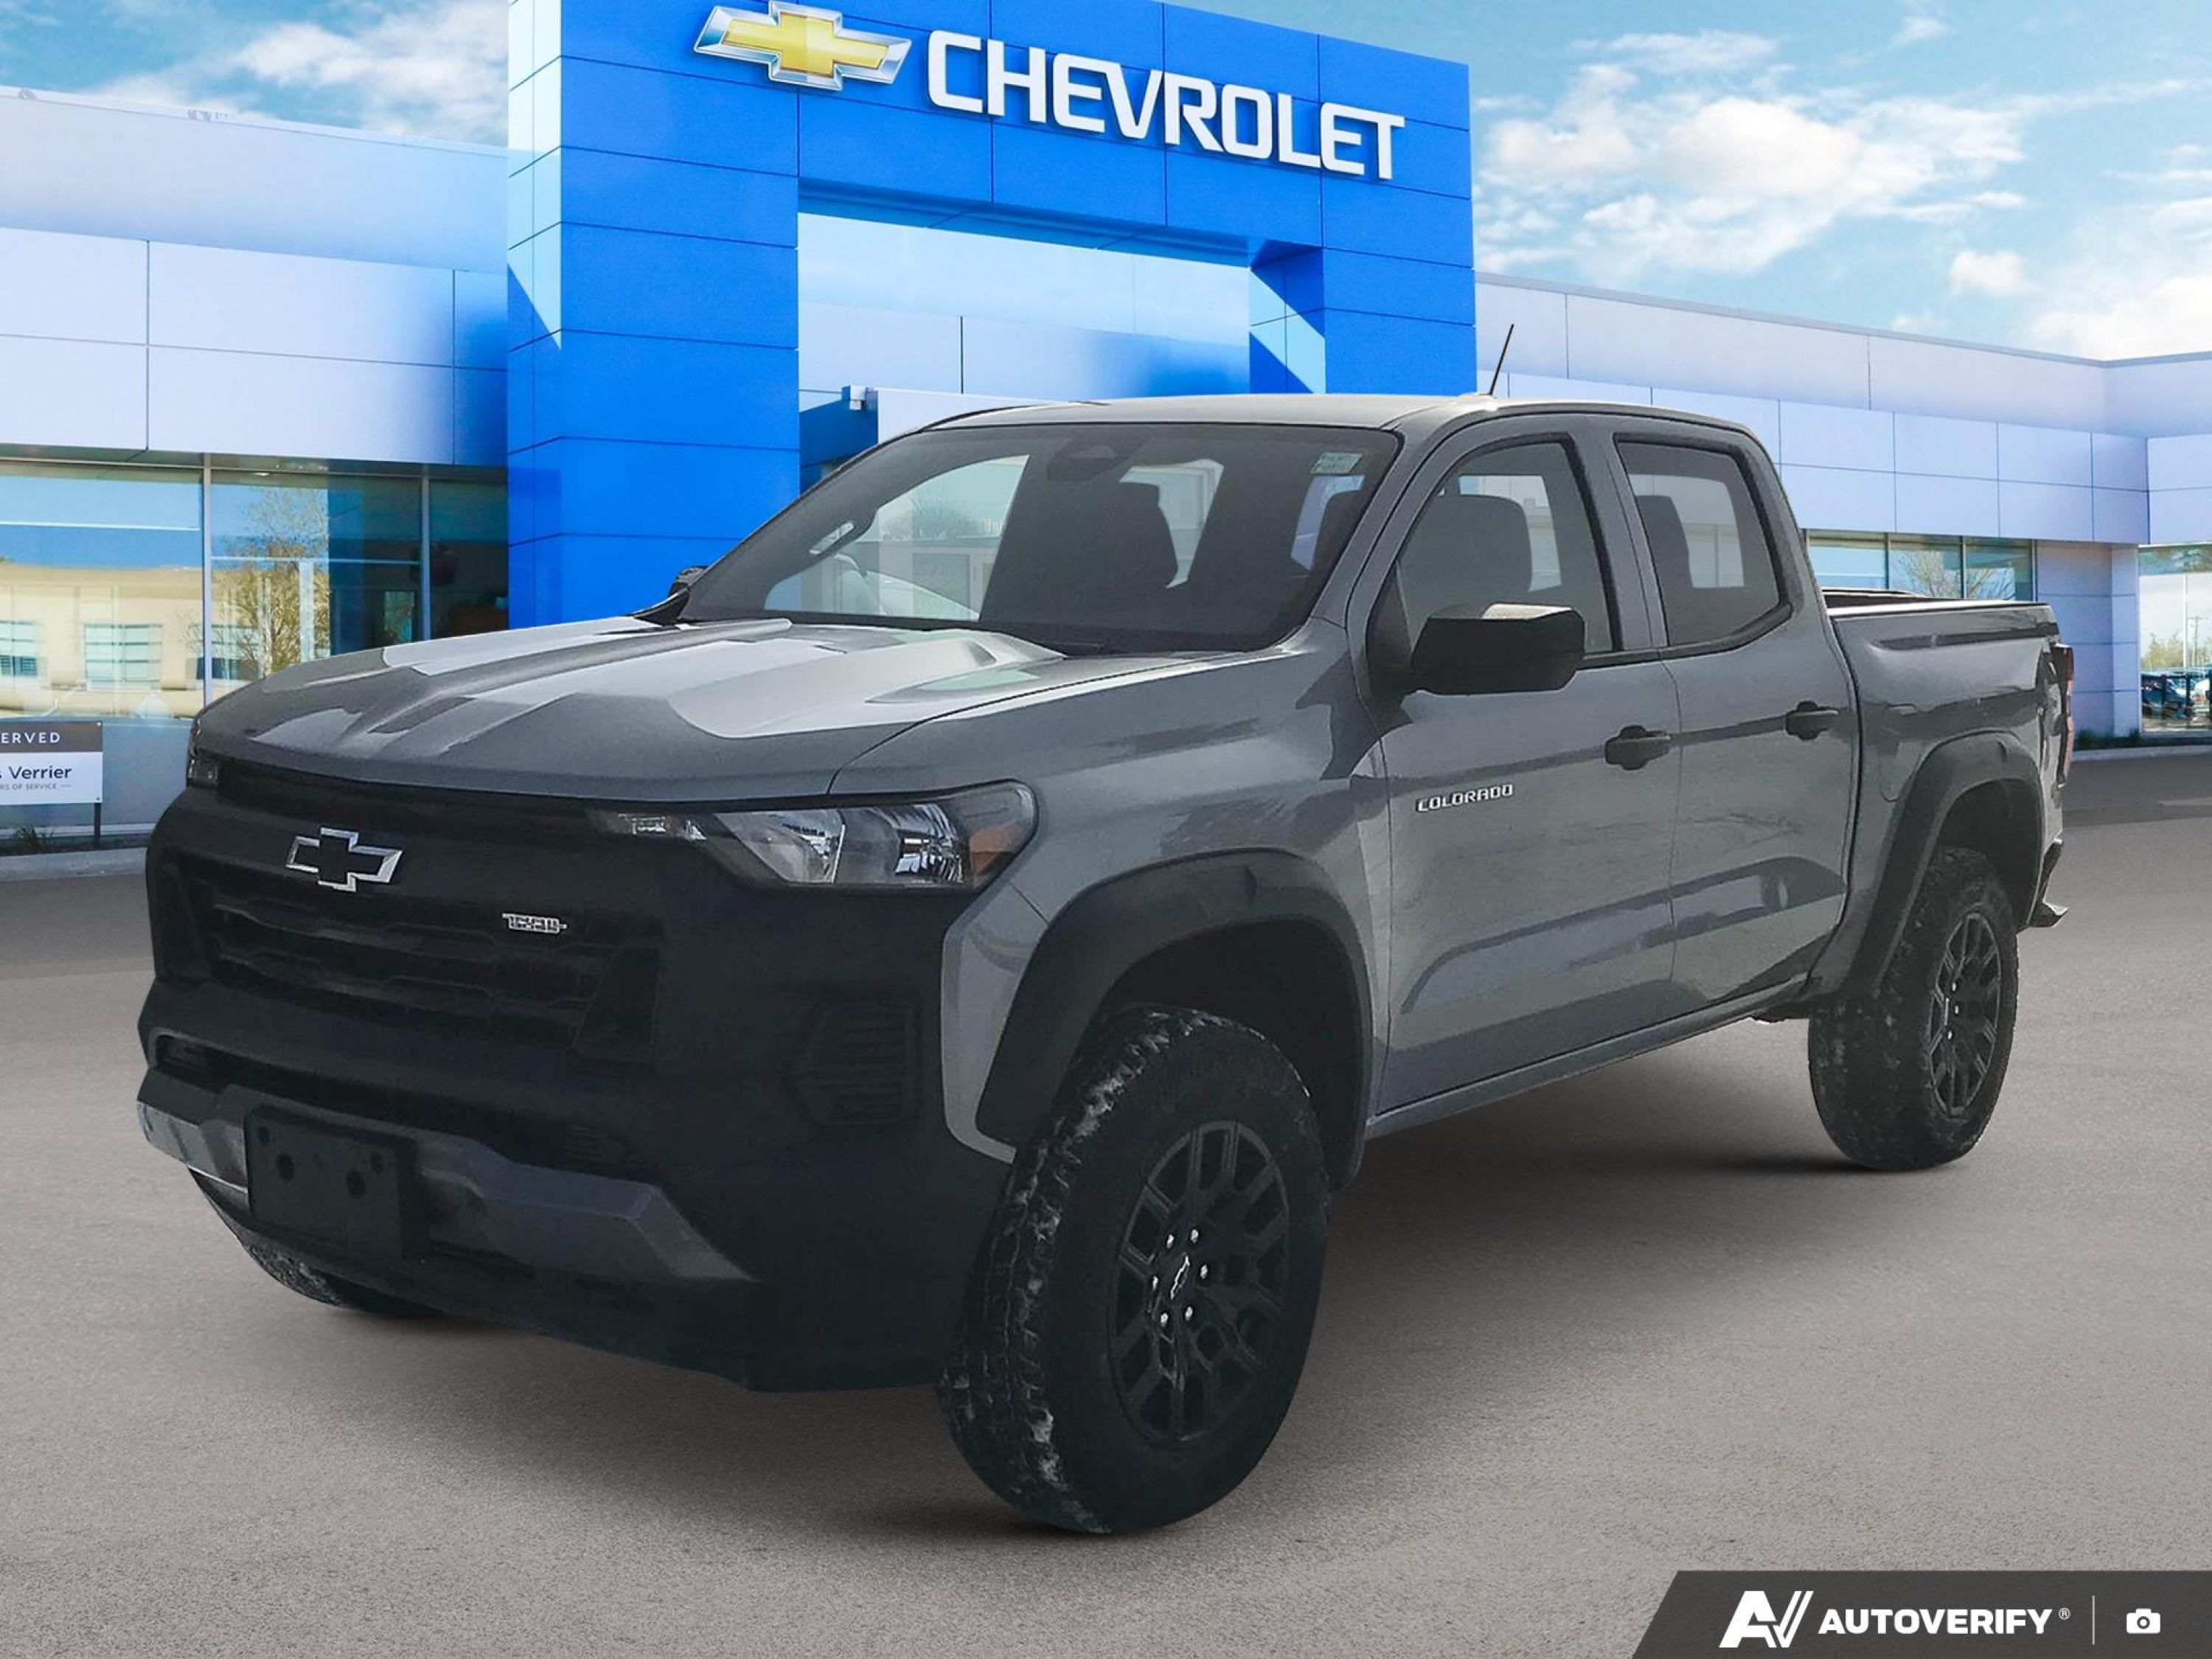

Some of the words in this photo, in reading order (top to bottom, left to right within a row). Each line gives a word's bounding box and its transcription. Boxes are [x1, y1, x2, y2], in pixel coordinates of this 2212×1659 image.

[928, 29, 1405, 180] CHEVROLET
[8, 765, 72, 779] Verrier
[26, 782, 57, 790] SERVICE
[1416, 784, 1514, 812] COLORADO
